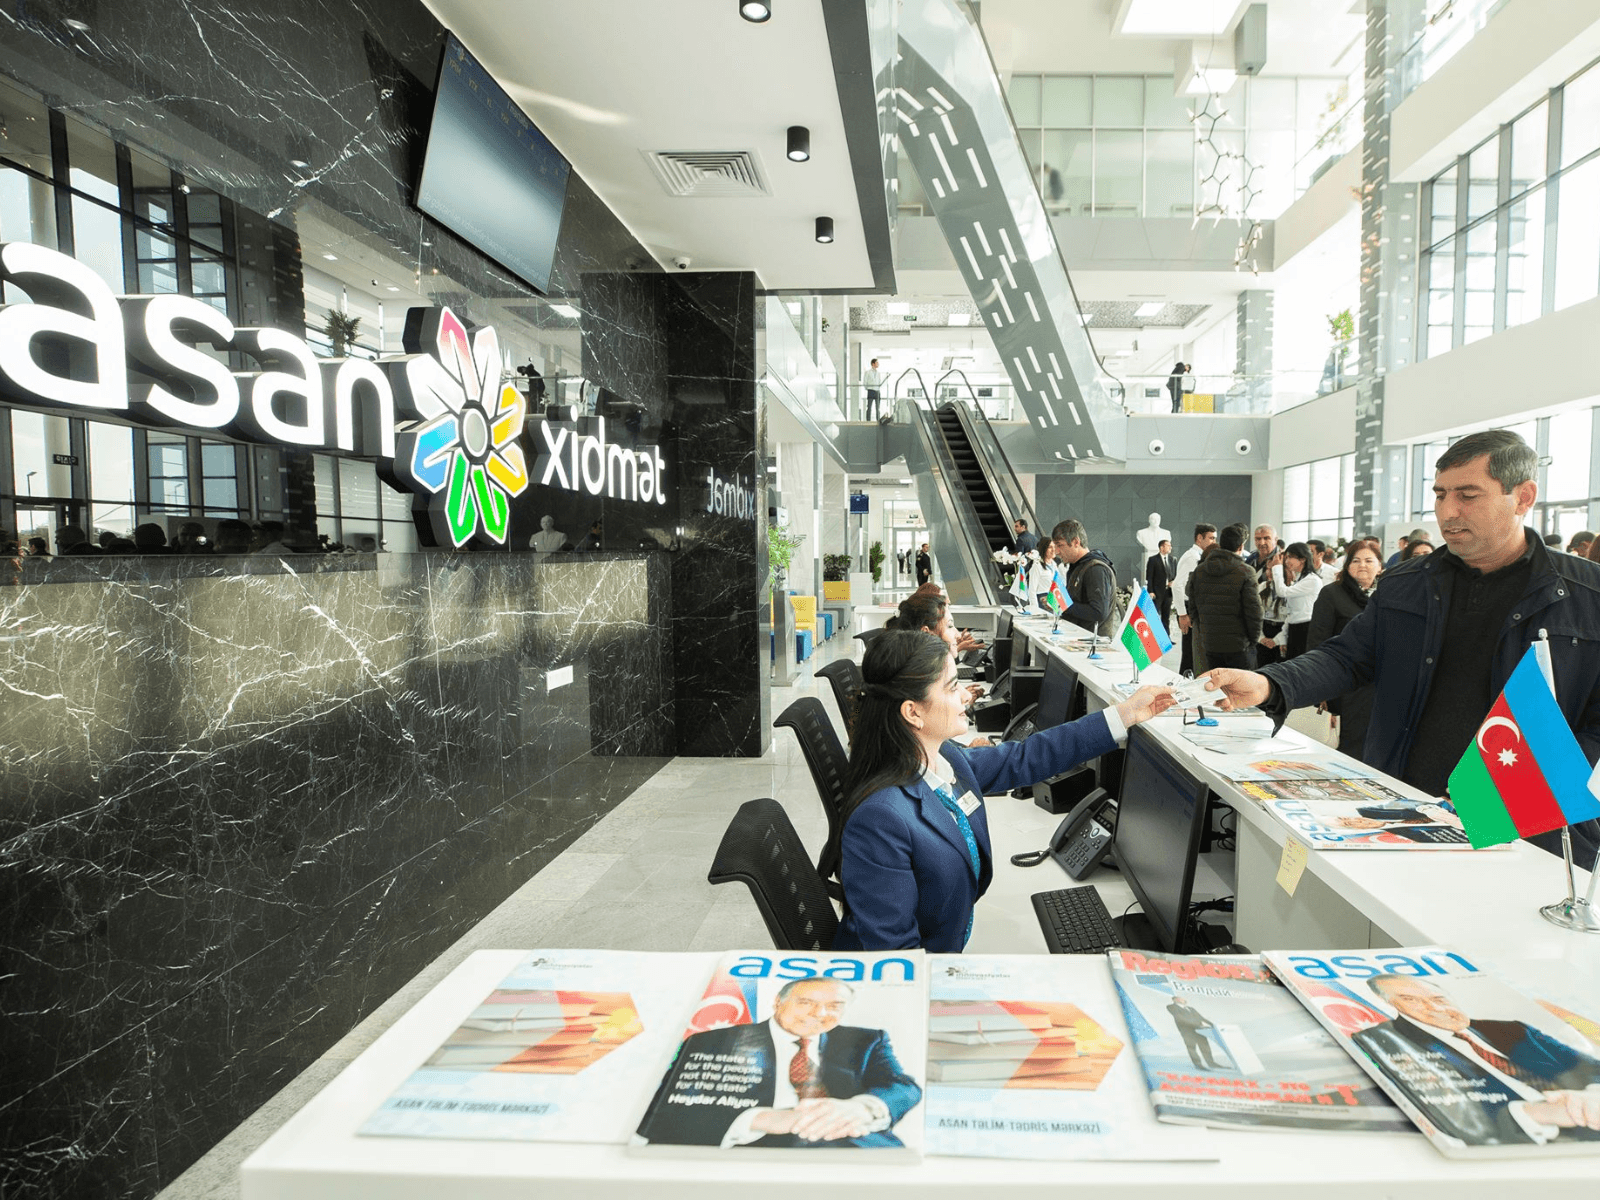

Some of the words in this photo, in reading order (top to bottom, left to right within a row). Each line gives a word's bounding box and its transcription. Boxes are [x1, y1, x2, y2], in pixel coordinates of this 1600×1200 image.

[0, 242, 395, 458] asan
[541, 405, 667, 505] xidmat
[729, 956, 915, 982] asan
[1288, 951, 1479, 979] asan
[684, 1062, 701, 1071] for
[702, 1062, 722, 1072] the
[701, 1071, 721, 1081] the
[675, 1080, 693, 1090] for
[694, 1081, 715, 1090] the
